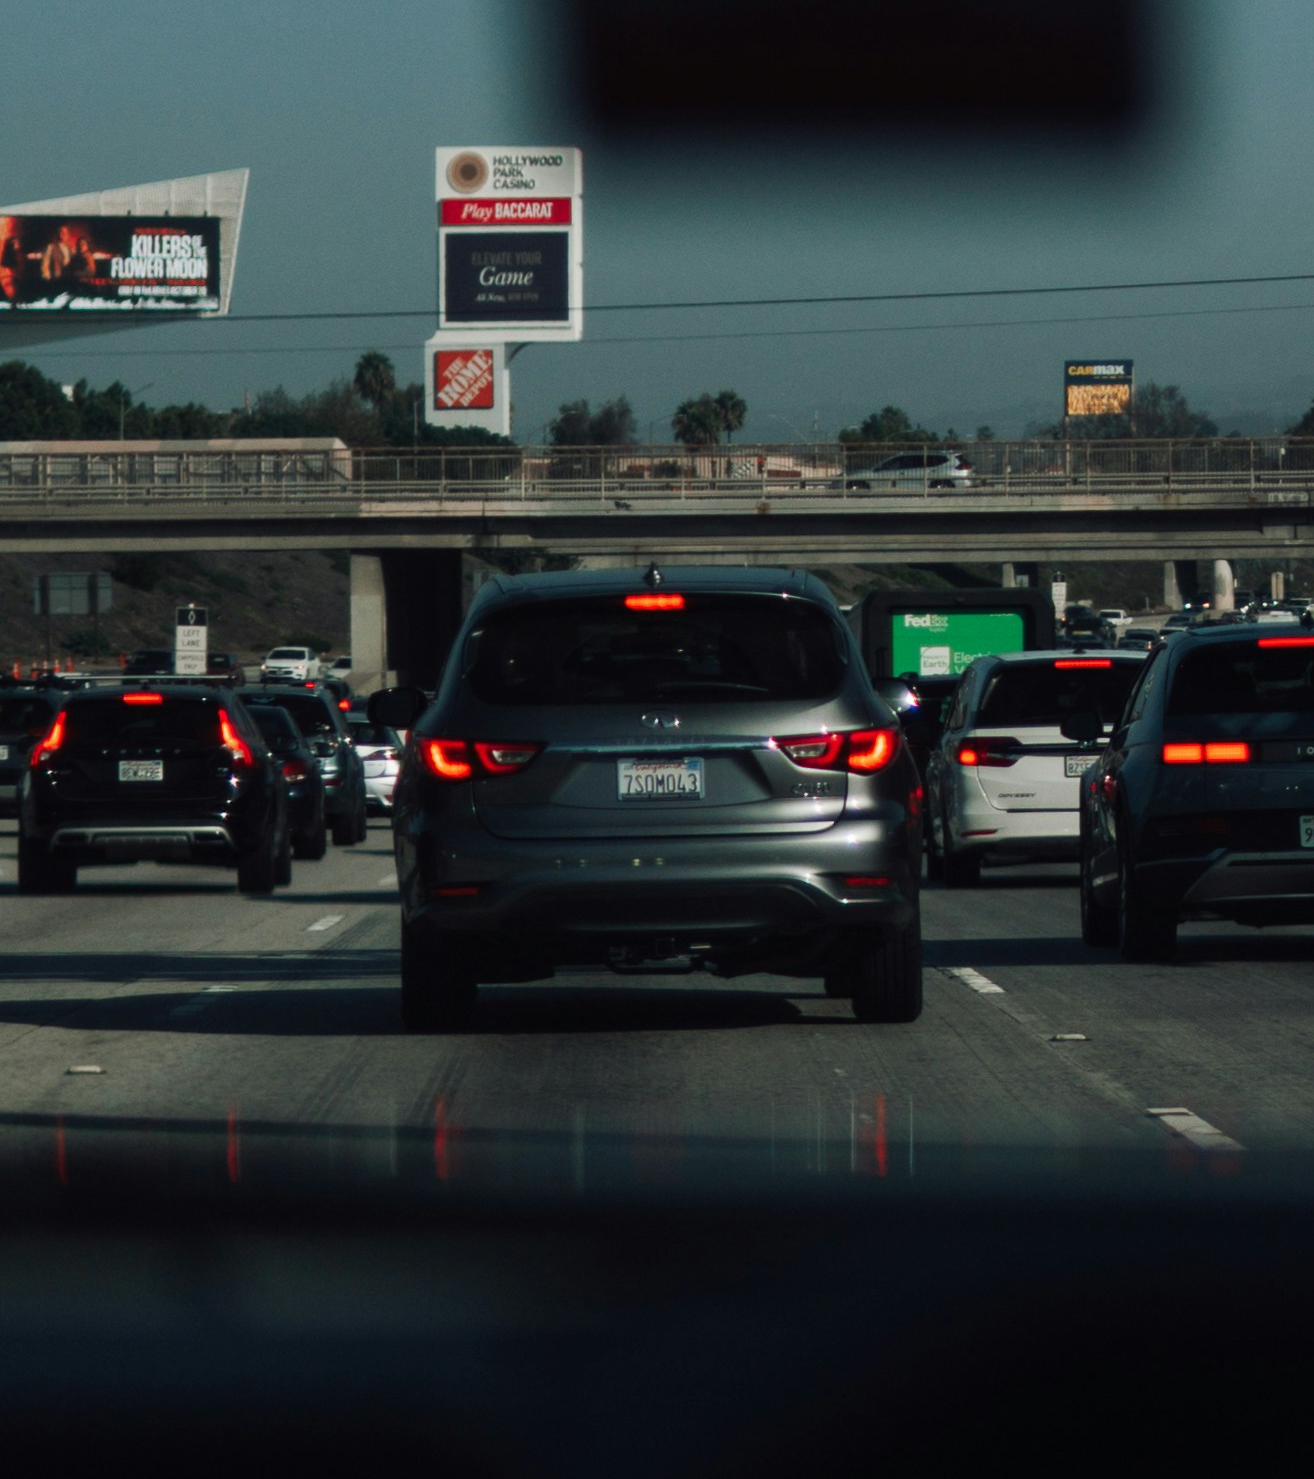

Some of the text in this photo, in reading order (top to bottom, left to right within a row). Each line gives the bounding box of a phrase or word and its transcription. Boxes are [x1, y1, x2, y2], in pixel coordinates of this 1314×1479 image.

[493, 155, 563, 167] HOLLYWOOD
[493, 167, 524, 178] PARK
[493, 178, 536, 190] CASINO
[461, 202, 553, 223] Play BACCARAT
[131, 234, 192, 259] KILLERS
[111, 257, 208, 279] FLOWER MOON
[514, 250, 543, 265] YOUR
[479, 265, 534, 286] Game
[437, 349, 493, 407] HOME
[442, 355, 465, 380] THE
[459, 370, 493, 407] DEPOT
[923, 660, 948, 668] Earth
